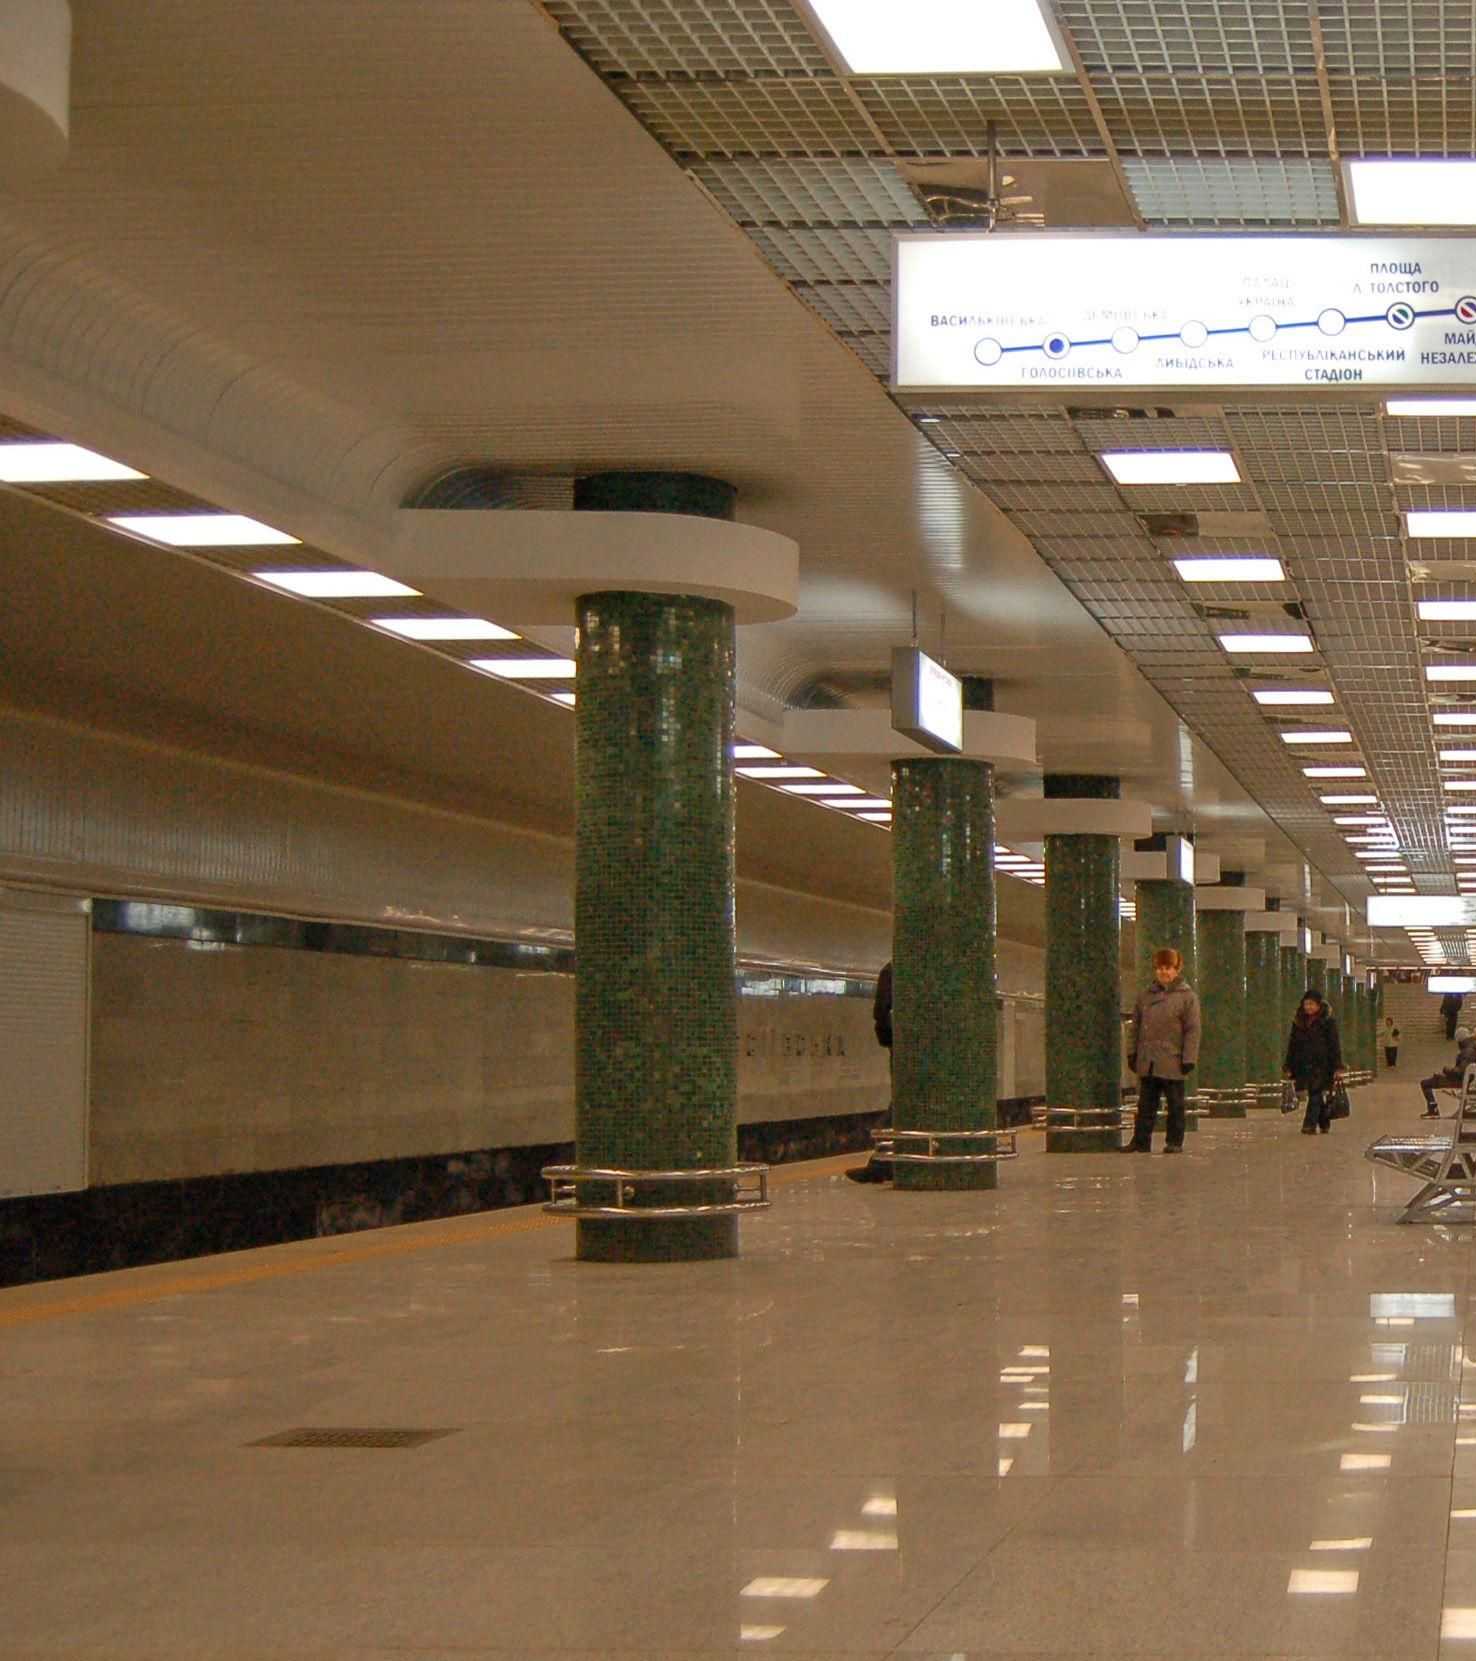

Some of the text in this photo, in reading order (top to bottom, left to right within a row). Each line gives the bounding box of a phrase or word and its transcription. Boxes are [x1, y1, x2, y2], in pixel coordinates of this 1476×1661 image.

[1370, 263, 1423, 276] ПЛОЩА
[1370, 281, 1440, 293] ТОЛСТОГО
[1262, 347, 1406, 361] РЕСПУБЛІКАНСЬКИЙ
[1304, 369, 1363, 382] СТАДІОН
